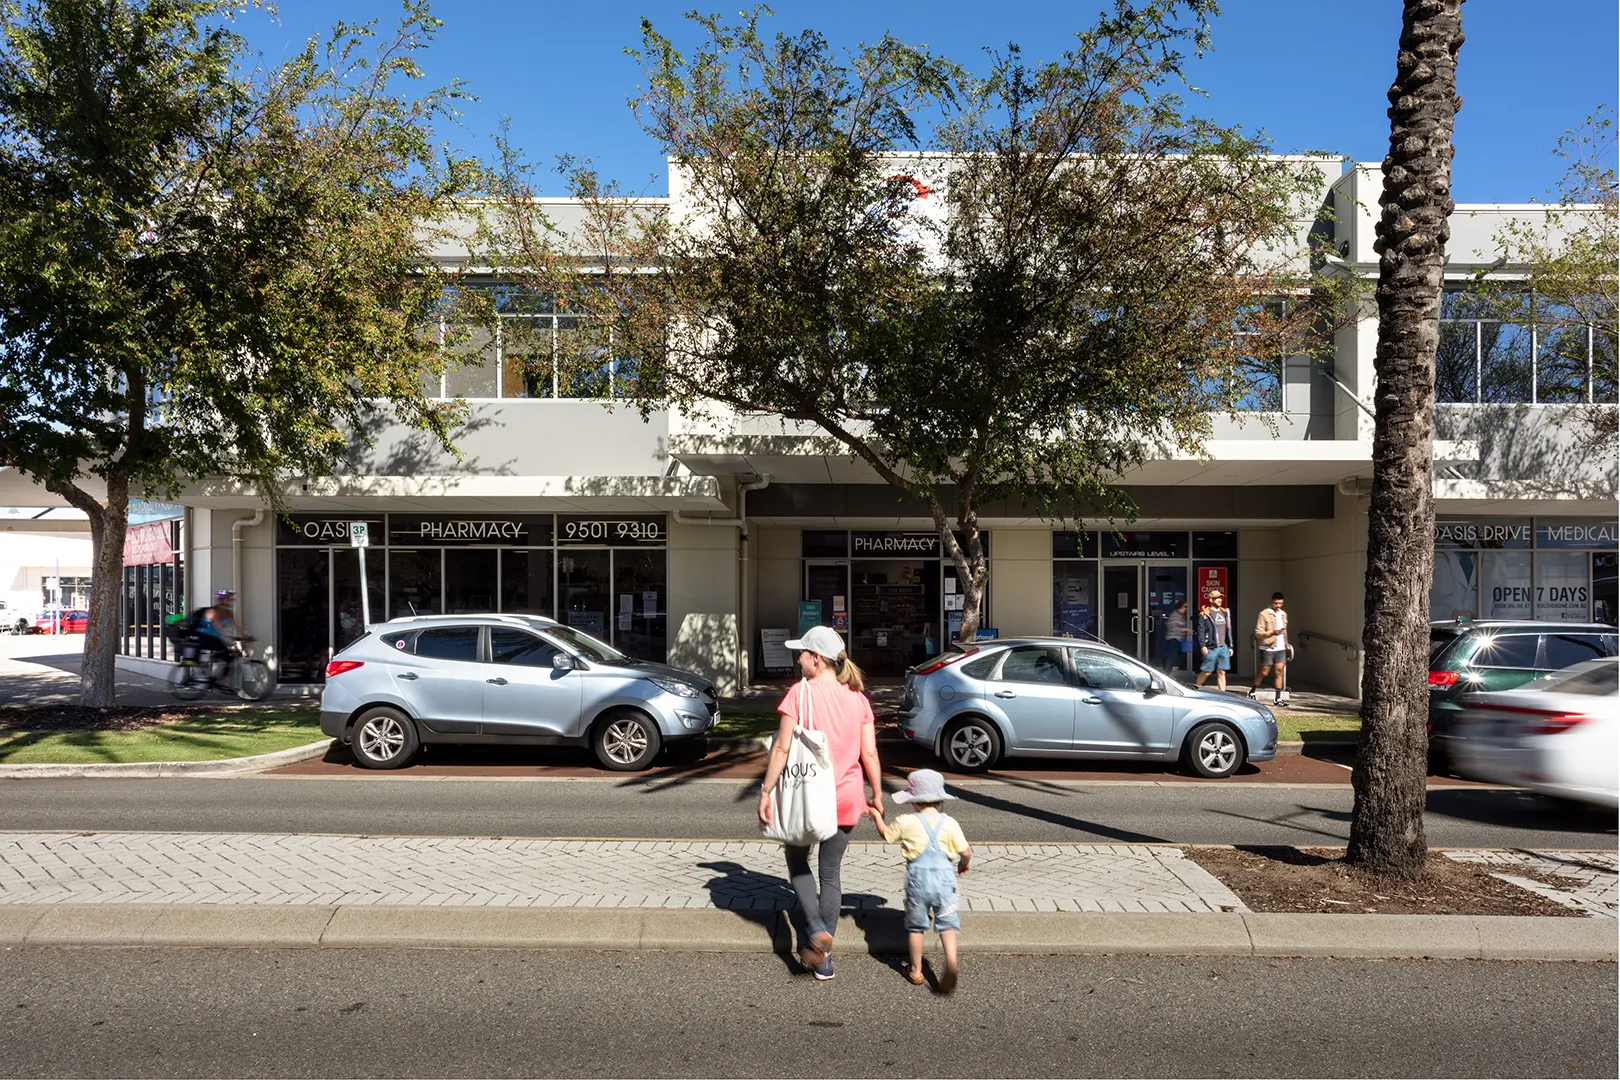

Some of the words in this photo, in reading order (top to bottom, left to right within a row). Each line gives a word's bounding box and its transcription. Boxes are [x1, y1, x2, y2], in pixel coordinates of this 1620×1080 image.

[304, 521, 350, 538] OASI
[420, 522, 523, 538] PHARMACY
[565, 522, 608, 539] 9501
[617, 522, 658, 539] 9310
[352, 525, 366, 535] 3P
[1484, 525, 1530, 540] DRIVE
[1548, 526, 1619, 541] MEDICAL
[855, 537, 936, 551] PHARMACY
[1493, 587, 1530, 601] OPEN
[1536, 587, 1545, 602] 7
[1549, 587, 1587, 602] DAYS
